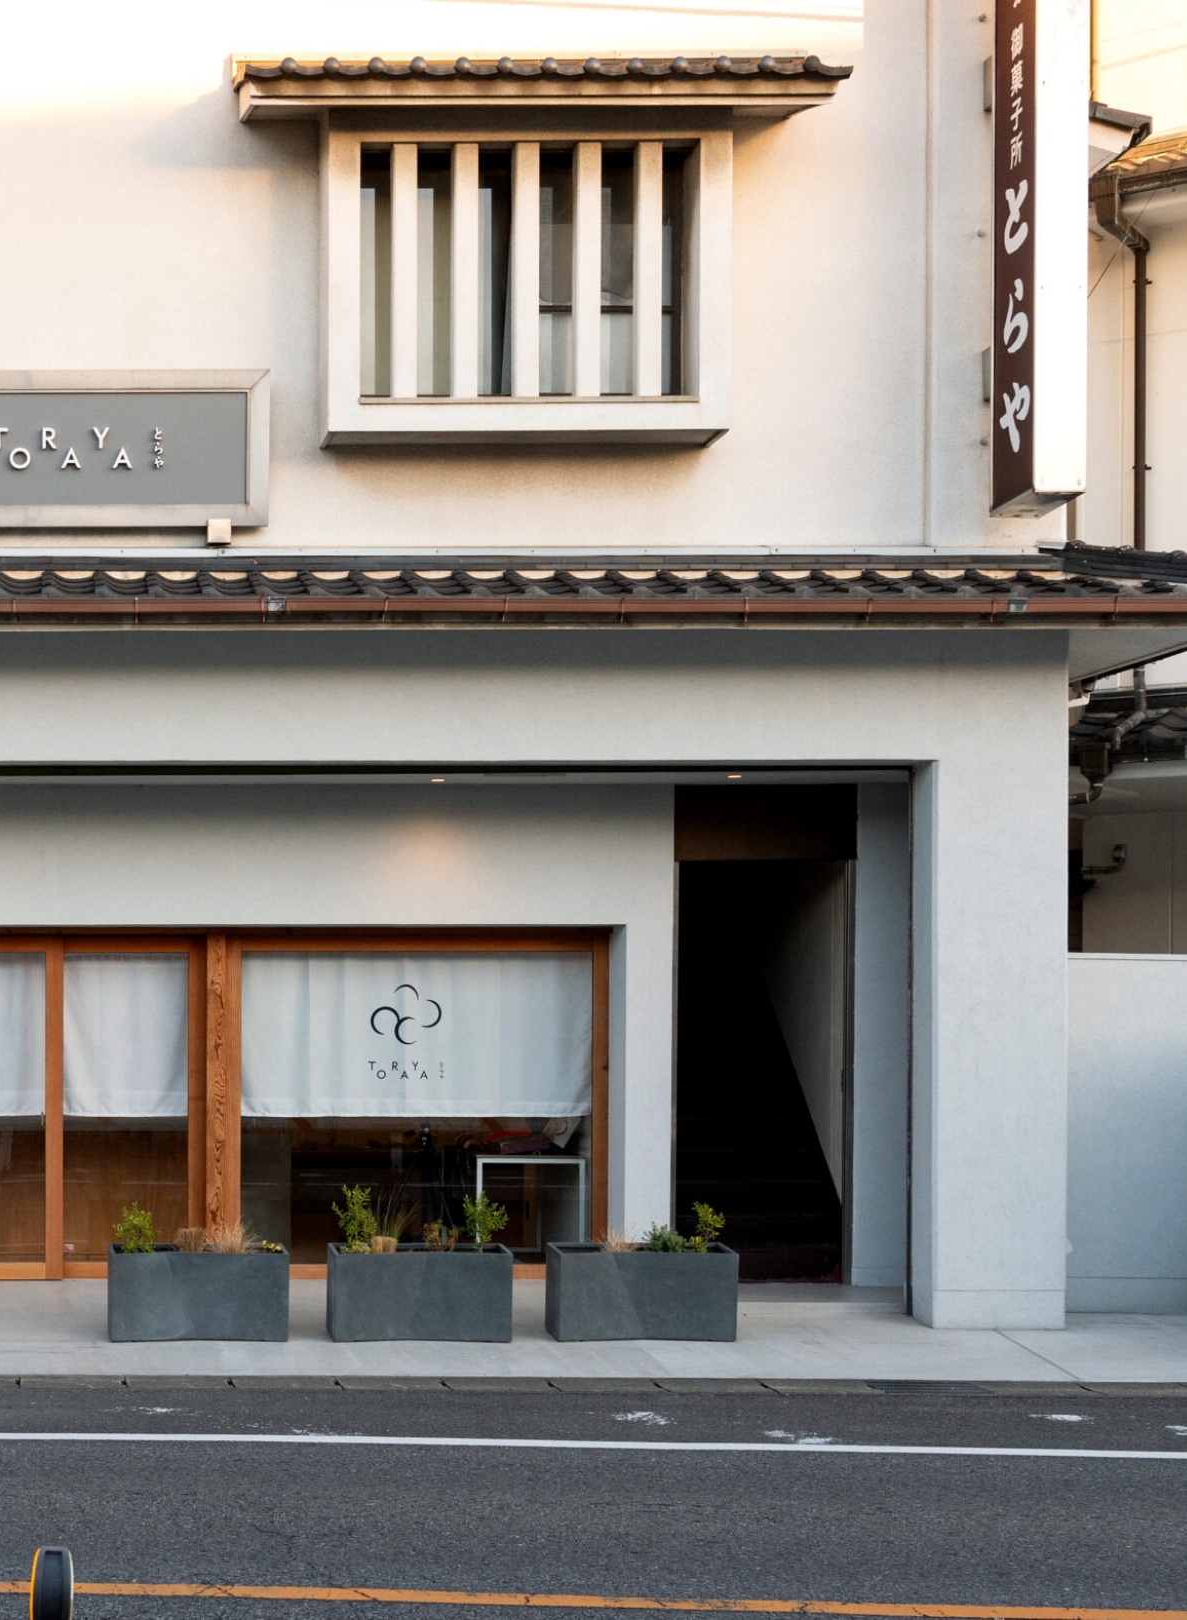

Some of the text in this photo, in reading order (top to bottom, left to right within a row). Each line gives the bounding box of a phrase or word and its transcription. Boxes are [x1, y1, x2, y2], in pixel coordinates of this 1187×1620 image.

[999, 179, 1031, 453] とらや
[153, 426, 165, 469] とらや
[367, 1060, 429, 1080] TORAYA
